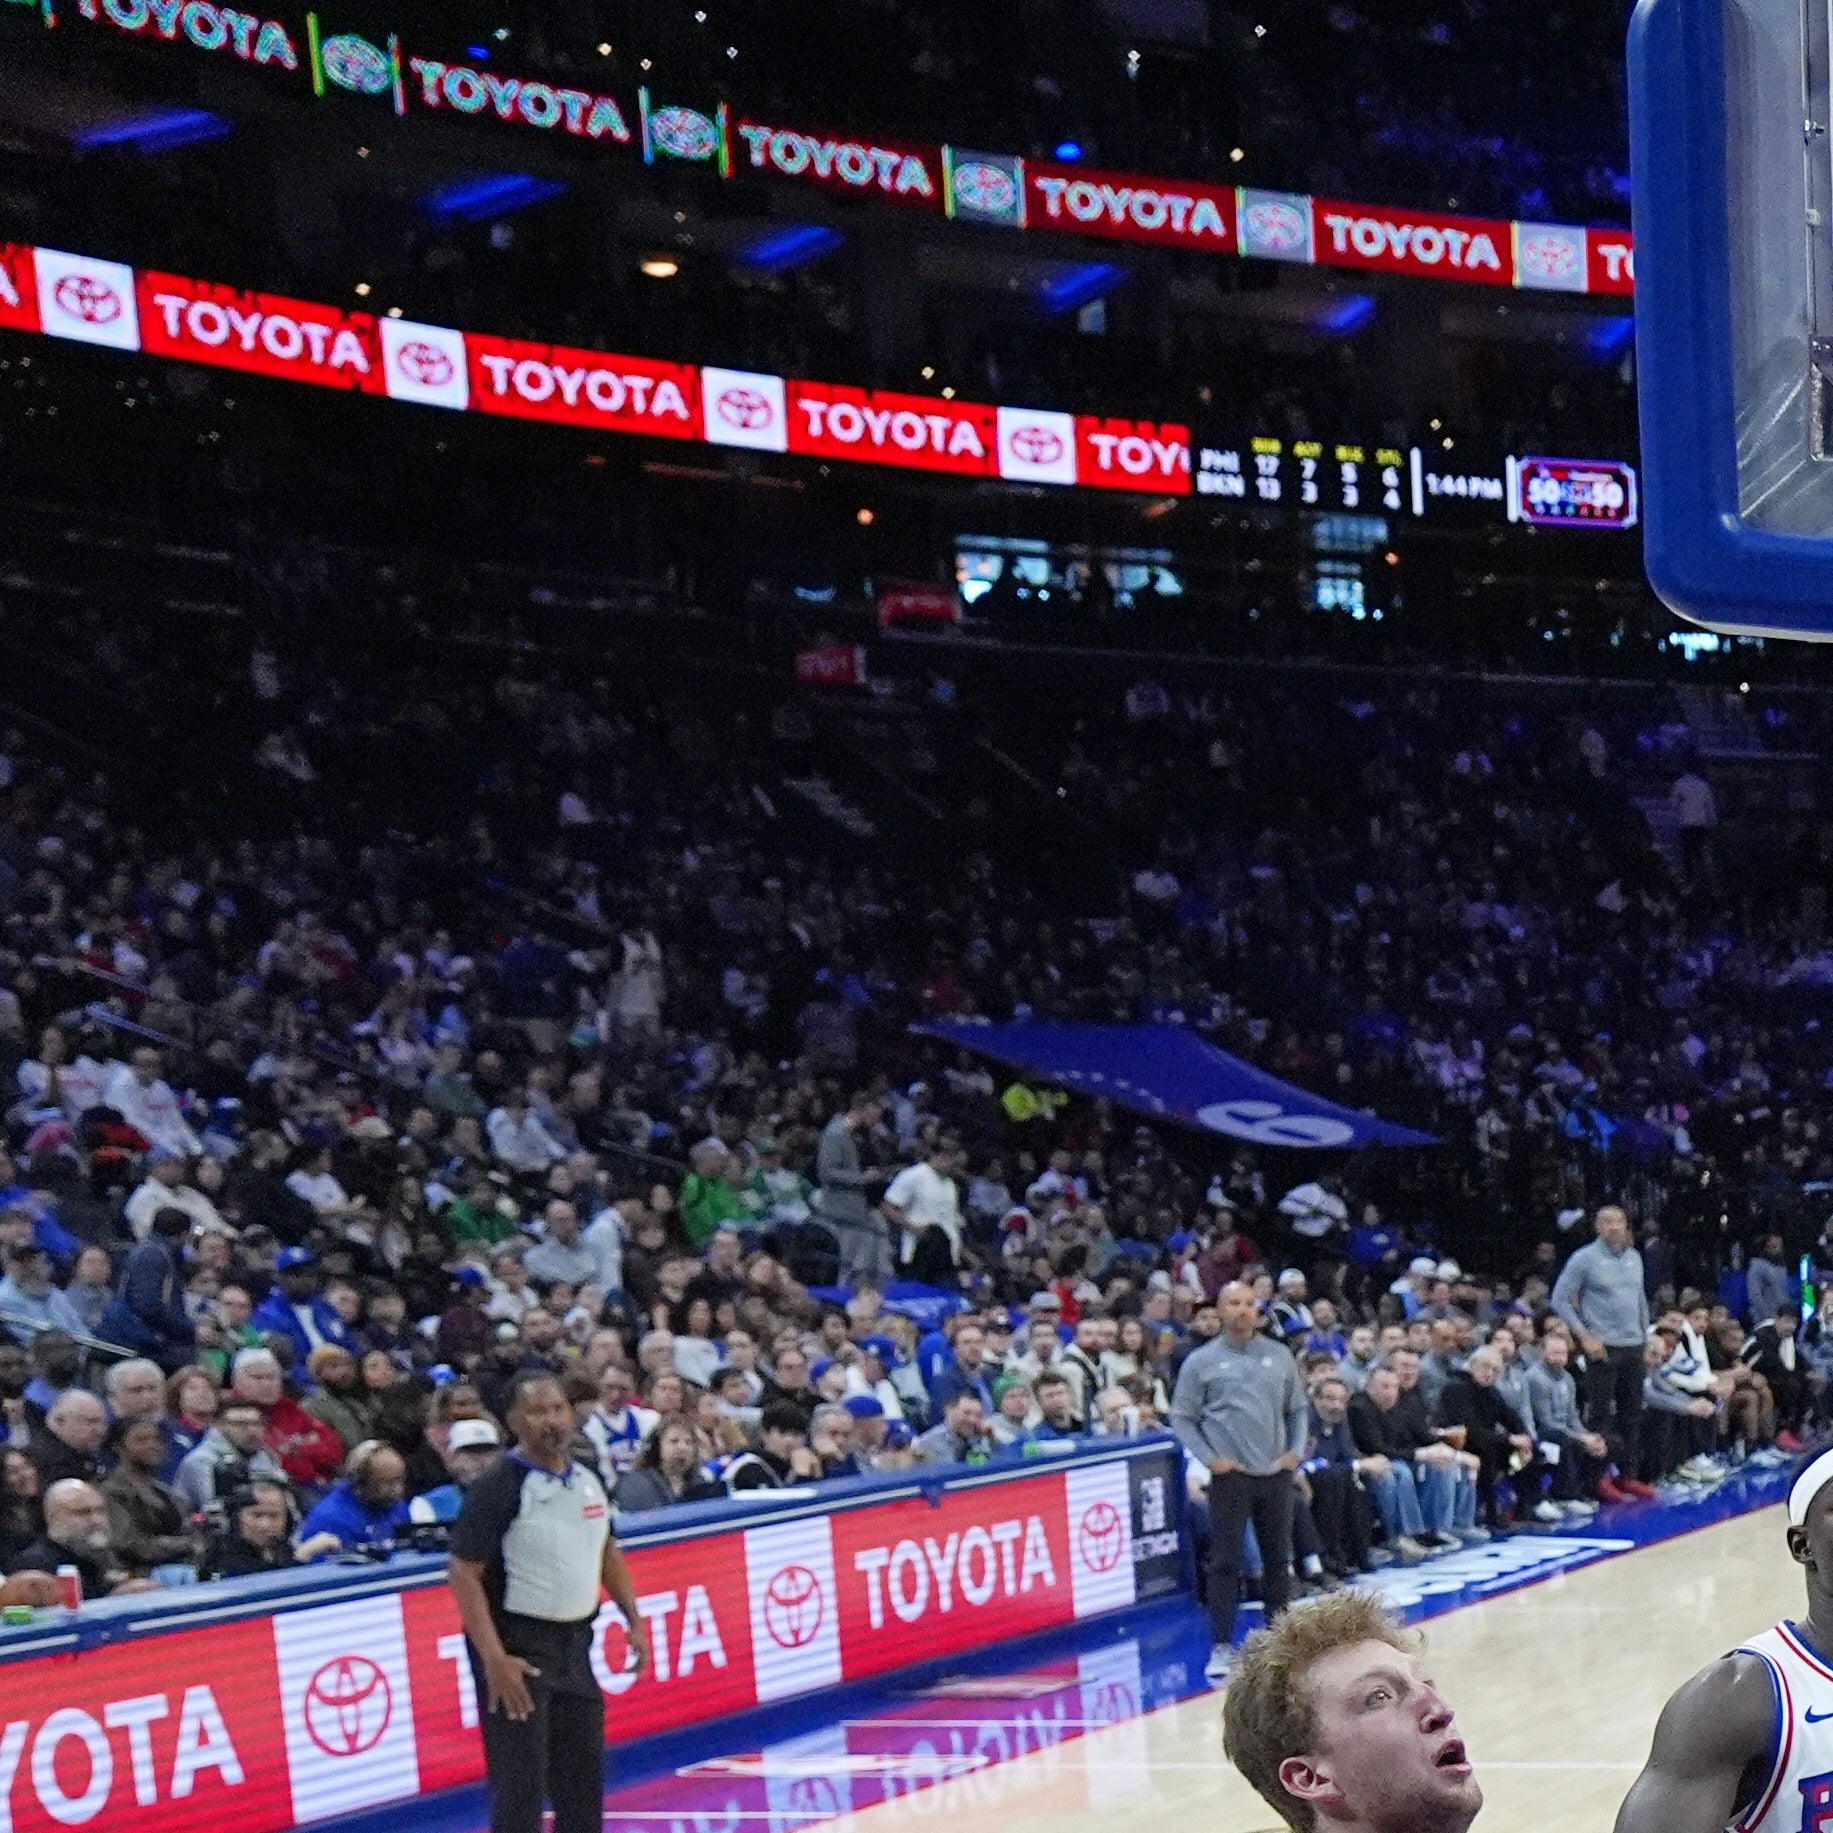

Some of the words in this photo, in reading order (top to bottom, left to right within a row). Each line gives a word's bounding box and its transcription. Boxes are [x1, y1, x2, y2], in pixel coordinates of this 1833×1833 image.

[79, 0, 298, 69] OYOTA
[410, 58, 628, 141] TOYOTA
[739, 123, 934, 197] TOYOTA
[1035, 176, 1226, 237] TOYOTA
[1324, 213, 1501, 270] TOYOTA
[153, 292, 371, 374] TOYOTA
[480, 353, 690, 422] TOYOTA
[798, 398, 985, 458] TOYOTA
[855, 1515, 1057, 1629] TOYOTA
